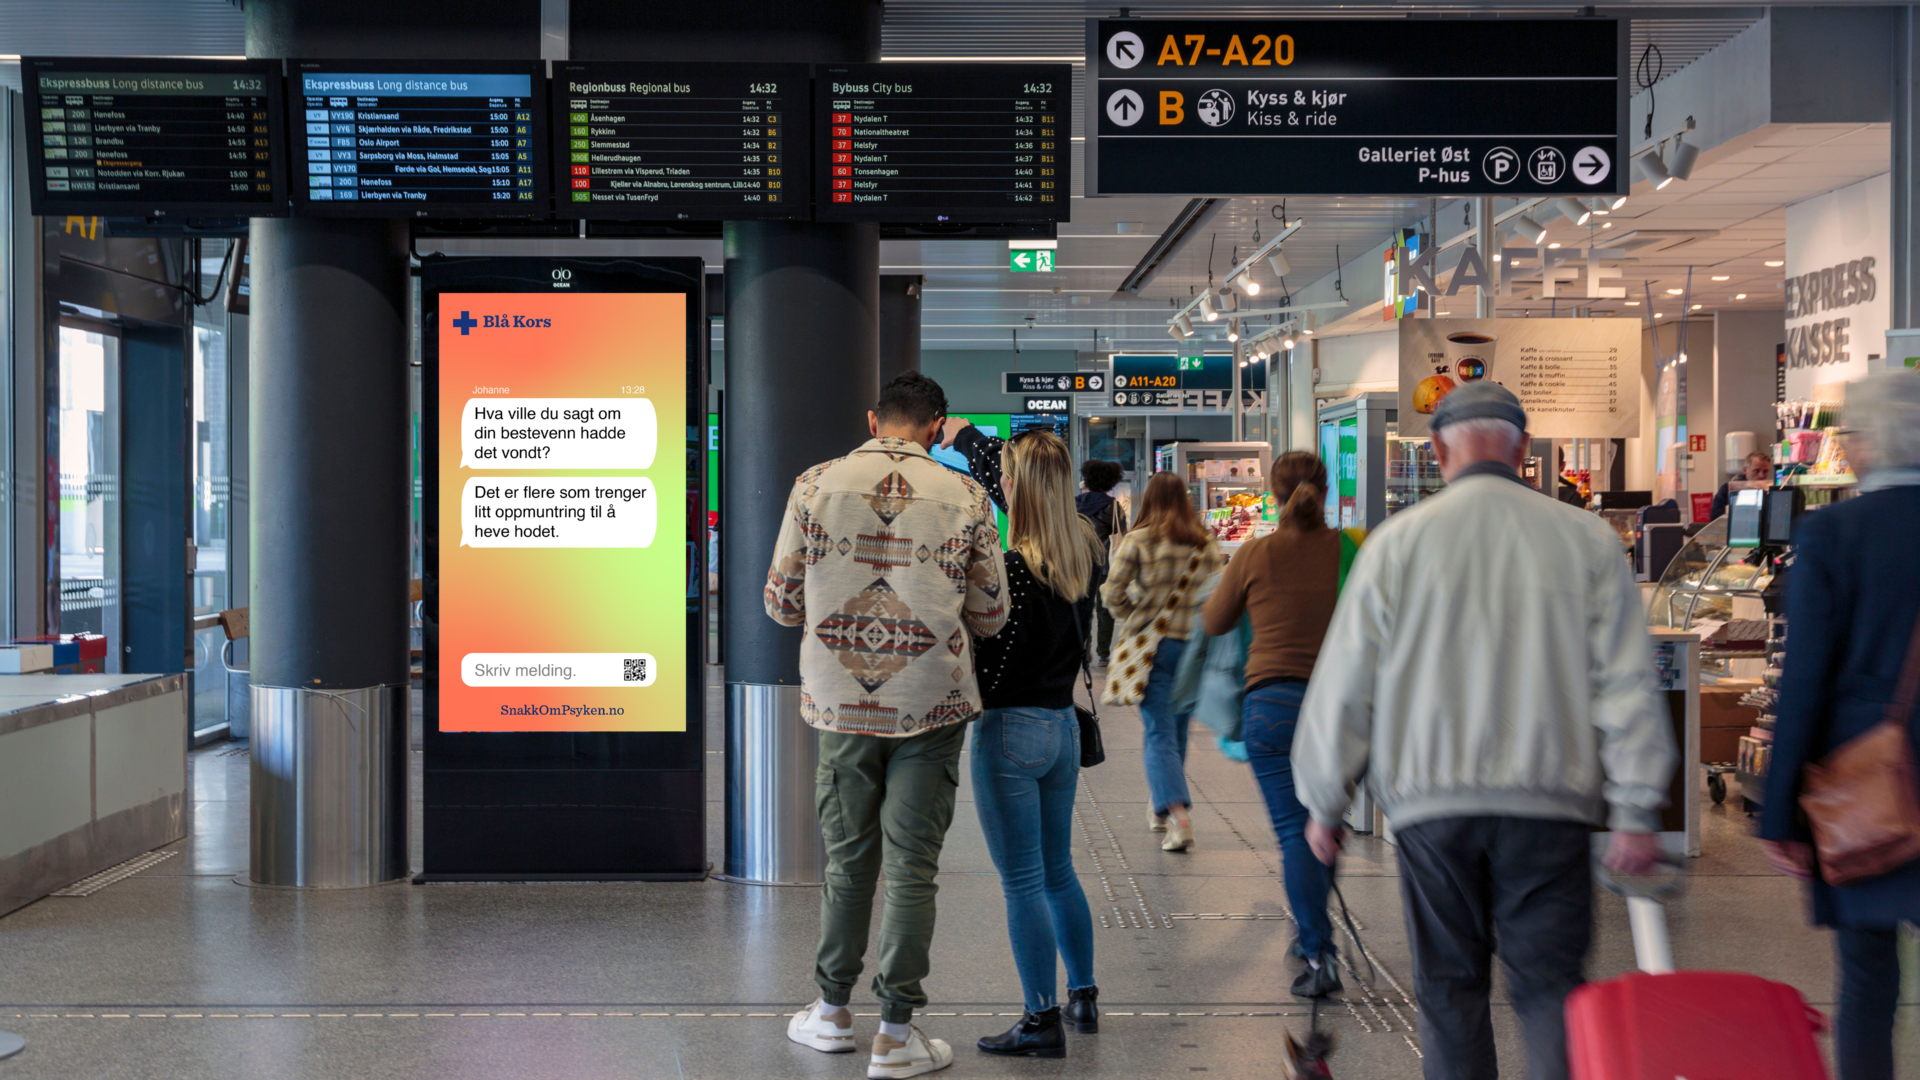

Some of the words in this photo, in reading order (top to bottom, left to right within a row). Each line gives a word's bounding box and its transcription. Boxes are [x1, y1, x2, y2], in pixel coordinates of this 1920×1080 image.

[1157, 34, 1295, 66] A7-A20
[40, 78, 110, 90] Ekspressbuss
[112, 79, 138, 92] Long
[140, 79, 183, 90] distance
[186, 79, 204, 90] bus
[233, 80, 261, 90] 14:32
[305, 79, 374, 91] Ekspressbuss
[377, 80, 402, 92] Long
[405, 80, 447, 91] distance
[450, 80, 468, 91] bus
[570, 82, 626, 94] Regionbuss
[630, 82, 671, 94] Regional
[674, 82, 690, 93] bus
[750, 83, 777, 93] 14:32
[832, 83, 869, 94] Bybuss
[872, 83, 892, 94] City
[895, 83, 912, 93] bus
[1023, 83, 1052, 93] 14:32
[1248, 90, 1288, 108] Kyss
[1294, 90, 1306, 106] &
[1312, 90, 1346, 108] kjør
[72, 110, 85, 118] 200
[94, 111, 125, 119] Hønefoss
[1159, 90, 1184, 126] B
[331, 112, 354, 120] VY190
[358, 112, 400, 120] Kristiansand
[490, 113, 508, 121] 15:00
[590, 114, 625, 123] Åsenhagen
[854, 115, 882, 124] Nydalen
[1248, 111, 1283, 126] Kiss
[1288, 111, 1299, 126] &
[1305, 111, 1337, 126] ride
[591, 128, 616, 136] Rykkinn
[854, 128, 909, 136] Nationaltheatret
[854, 141, 878, 150] Helsfyr
[591, 154, 641, 162] Hellerudhaugen
[1359, 146, 1436, 163] Galleriet
[1442, 145, 1470, 163] Øst
[854, 168, 899, 176] Tonsenhagen
[1419, 167, 1470, 183] P-hus
[361, 178, 392, 186] Hønefoss
[1397, 247, 1626, 299] KAFFE
[1785, 256, 1876, 320] EXPRESS
[483, 314, 509, 328] Blå
[513, 315, 551, 328] Kors
[1785, 317, 1850, 371] KASSE
[1458, 365, 1484, 377] MIX
[1075, 377, 1085, 389] B
[1129, 377, 1176, 387] A11-A20
[472, 386, 510, 394] Johanne
[621, 386, 645, 394] 13:28
[1028, 400, 1066, 410] OCEAN
[475, 407, 503, 420] Hva
[508, 407, 536, 420] ville
[541, 407, 558, 420] du
[563, 407, 594, 425] sagt
[598, 409, 621, 420] om
[474, 427, 496, 439] din
[501, 427, 576, 439] bestevenn
[580, 427, 626, 439] hadde
[474, 446, 497, 459] det
[502, 446, 551, 459] vondt?
[475, 486, 500, 499] Det
[504, 489, 519, 499] er
[523, 486, 555, 499] flere
[559, 489, 590, 499] som
[595, 486, 647, 503] trenger
[474, 505, 491, 518] litt
[495, 505, 586, 523] oppmuntring
[590, 505, 602, 518] til
[607, 504, 616, 518] å
[474, 525, 510, 538] heve
[514, 525, 559, 538] hodet.
[474, 664, 511, 678] Skriv
[515, 664, 577, 681] melding.
[500, 704, 625, 717] SnakkOmPsyken.no
